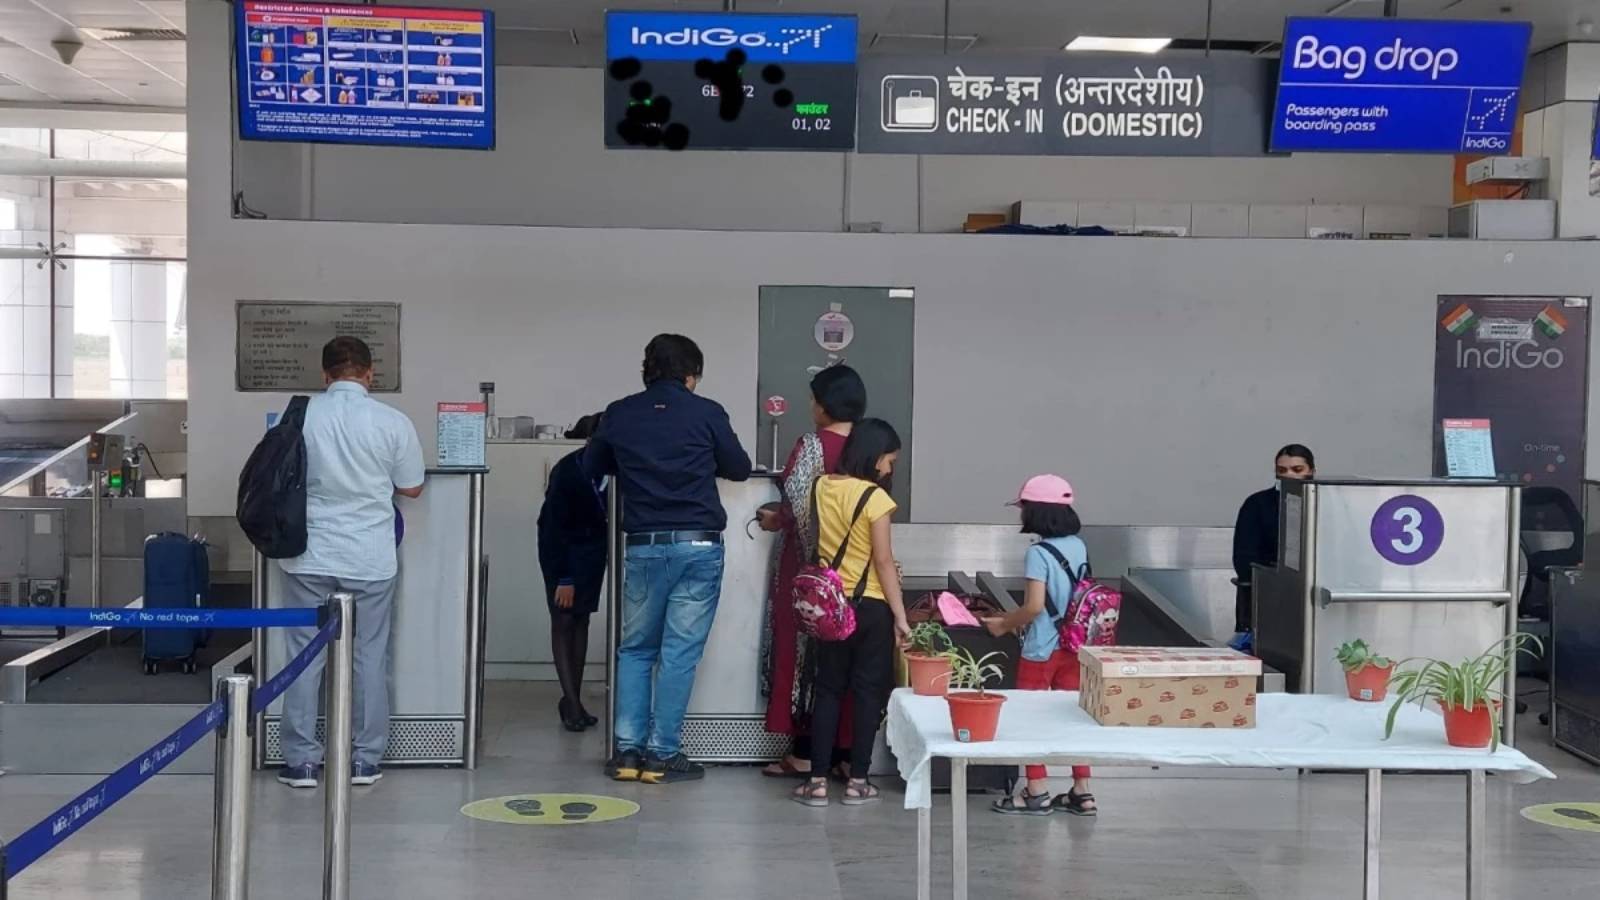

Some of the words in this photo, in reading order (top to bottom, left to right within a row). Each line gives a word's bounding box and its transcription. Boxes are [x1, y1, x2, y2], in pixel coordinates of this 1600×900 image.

[631, 27, 766, 47] IndiGo
[1293, 35, 1366, 79] Bag
[1374, 38, 1459, 80] drop
[947, 66, 1042, 106] चेक-इन
[1286, 103, 1360, 120] Passengers
[1362, 104, 1389, 117] with
[815, 118, 831, 130] 02
[946, 108, 1010, 133] CHECK
[1025, 109, 1043, 133] IN
[1062, 112, 1203, 138] (DOMESTIC)
[1284, 118, 1343, 134] boarding
[1344, 121, 1376, 134] pass
[1466, 136, 1506, 149] IndiGo
[1456, 339, 1564, 369] IndiGo
[1391, 507, 1424, 554] 3
[90, 611, 121, 621] IndiGo
[140, 612, 154, 621] No
[157, 612, 174, 621] red
[176, 613, 200, 623] tape
